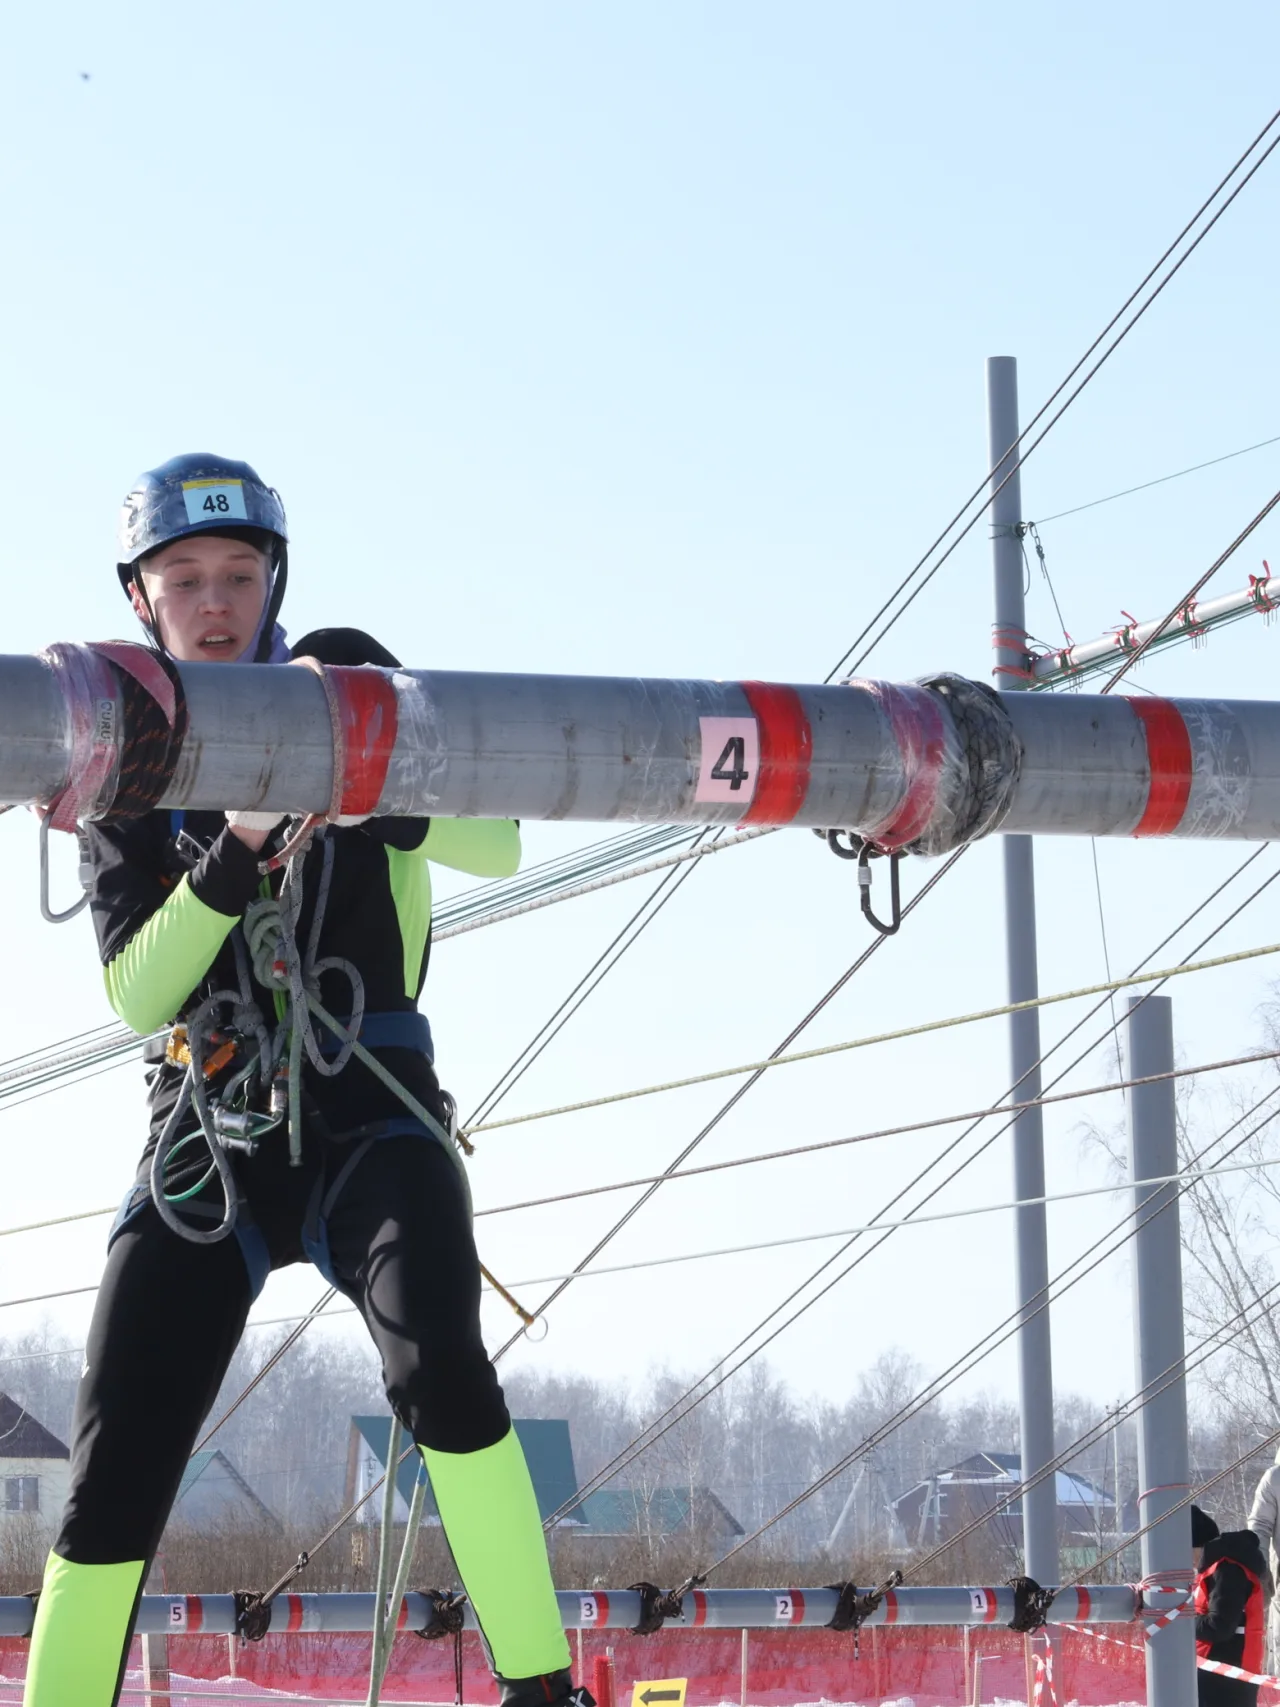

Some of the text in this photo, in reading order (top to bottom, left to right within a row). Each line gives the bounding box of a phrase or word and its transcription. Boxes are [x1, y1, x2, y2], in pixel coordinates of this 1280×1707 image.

[202, 493, 230, 513] 48
[710, 736, 749, 791] 4
[779, 1599, 789, 1615] 2
[973, 1593, 984, 1609] 1
[172, 1606, 182, 1622] 5
[583, 1601, 594, 1618] 3
